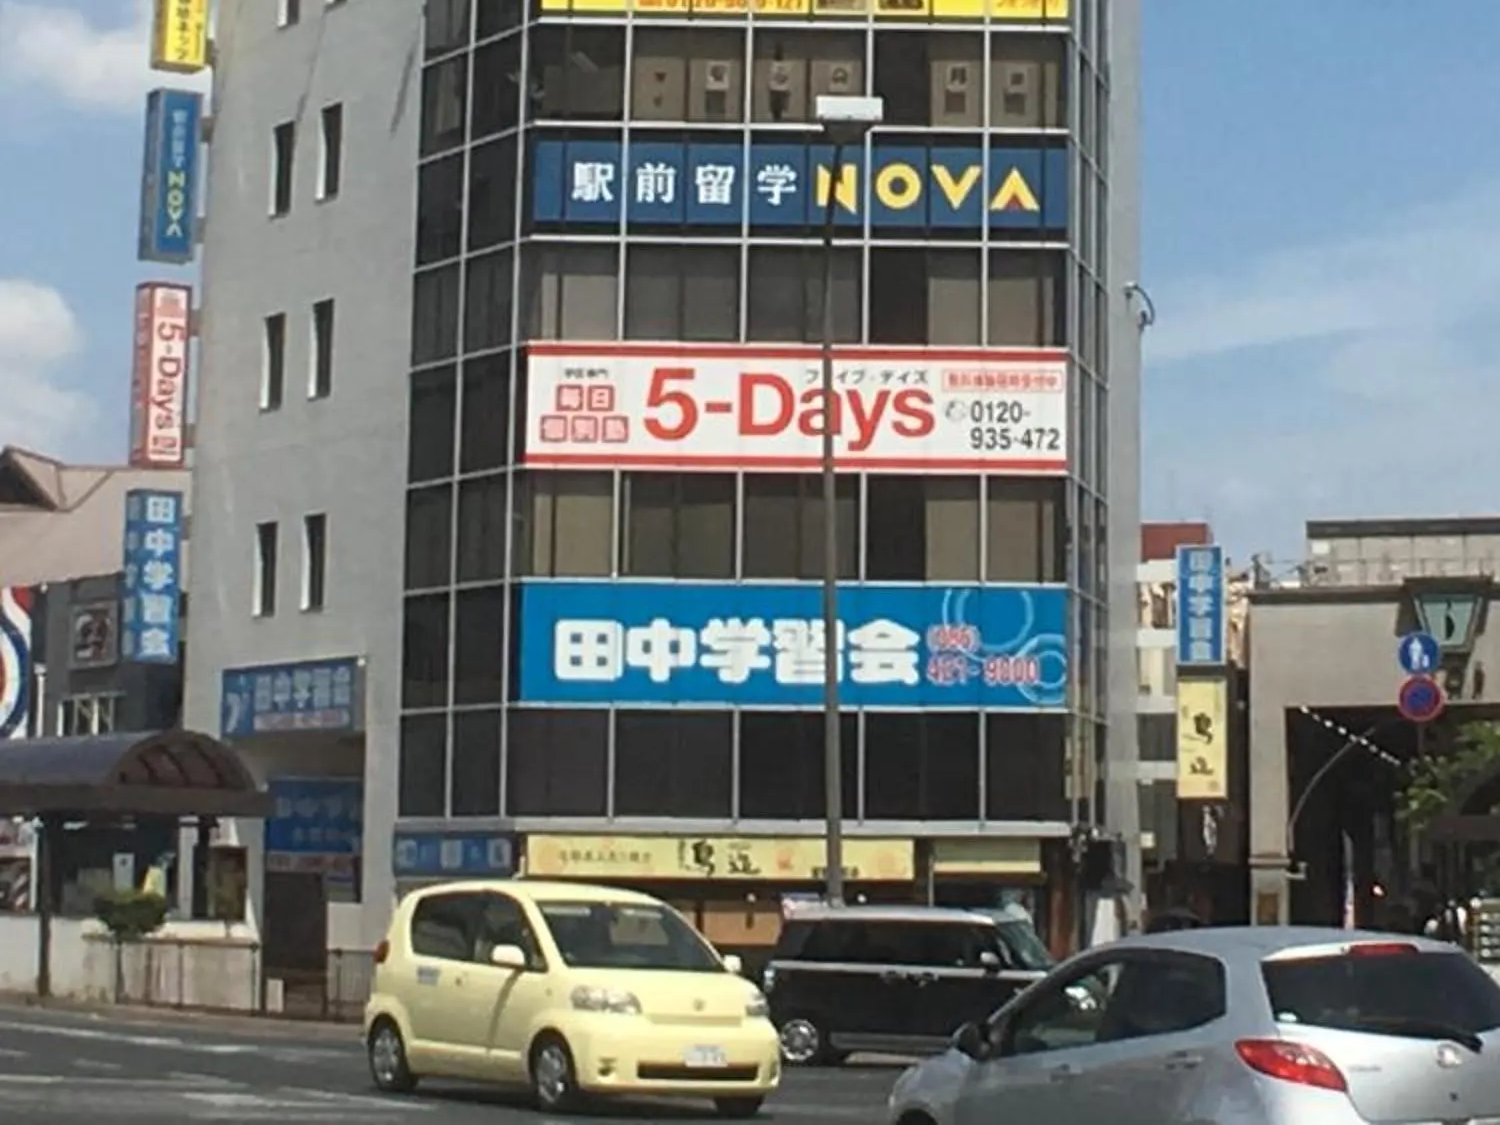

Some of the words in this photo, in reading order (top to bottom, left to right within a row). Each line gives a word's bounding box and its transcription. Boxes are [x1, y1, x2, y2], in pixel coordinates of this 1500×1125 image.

[166, 170, 186, 237] NOVA
[570, 161, 797, 206] 駅前留学
[817, 163, 1040, 215] NOVA
[151, 322, 185, 429] 5-Days
[643, 367, 935, 452] 5-Days
[141, 495, 176, 656] 田中学習会
[555, 617, 920, 686] 田中学習会
